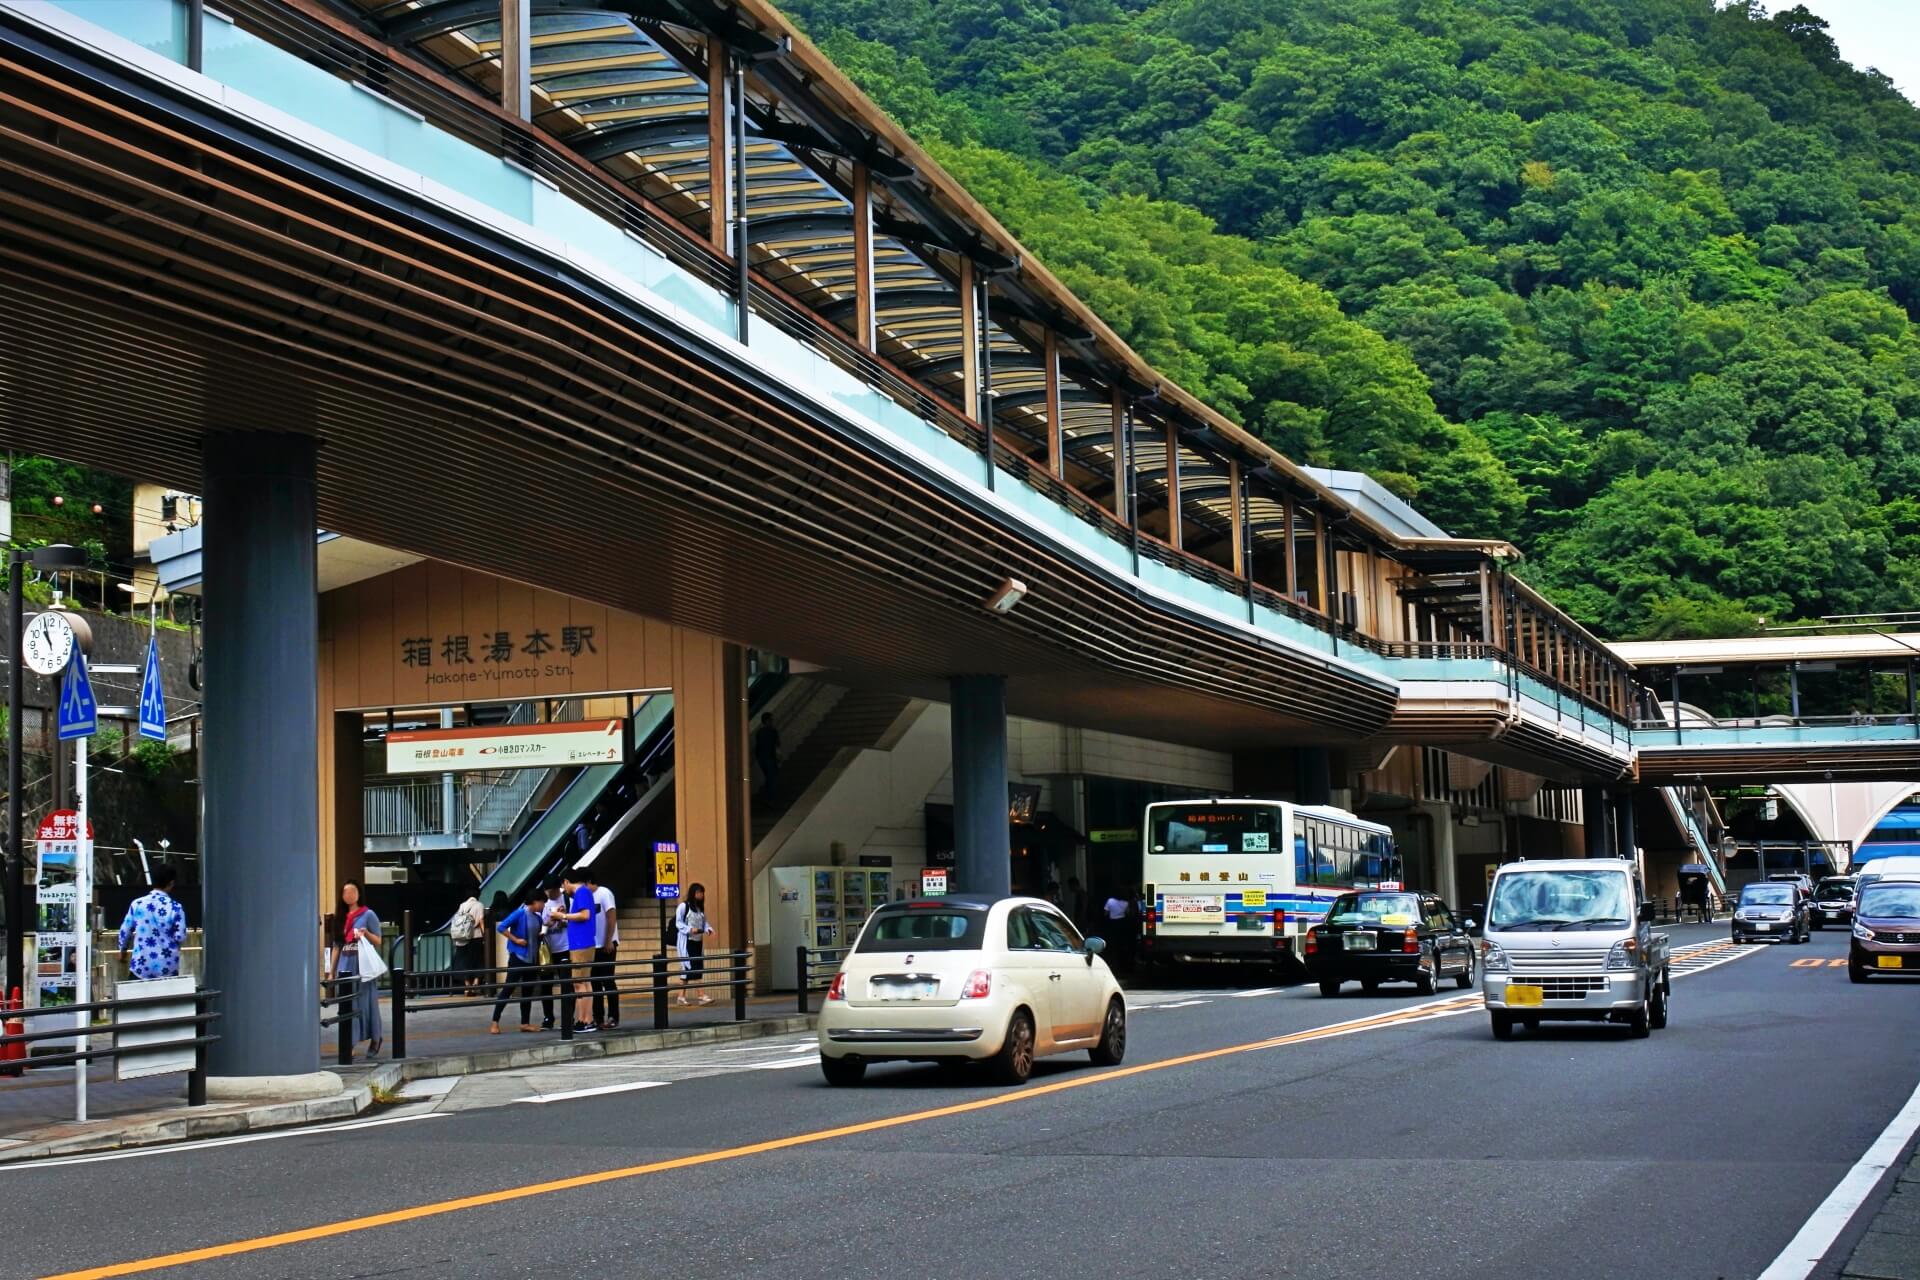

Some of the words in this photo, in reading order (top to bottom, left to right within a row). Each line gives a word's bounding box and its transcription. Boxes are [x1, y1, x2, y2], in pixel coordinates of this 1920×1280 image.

[48, 618, 55, 627] 12
[31, 630, 40, 638] 10
[64, 626, 69, 635] 2
[30, 641, 36, 649] 9
[66, 637, 71, 646] 3
[401, 626, 597, 667] 箱根湯本駅
[33, 650, 38, 659] 8
[40, 658, 45, 666] 7
[48, 660, 53, 668] 6
[57, 656, 62, 665] 5
[425, 667, 539, 684] Hakone-Yumoto
[544, 665, 574, 677] Stn.
[1180, 872, 1248, 881] 箱根登山
